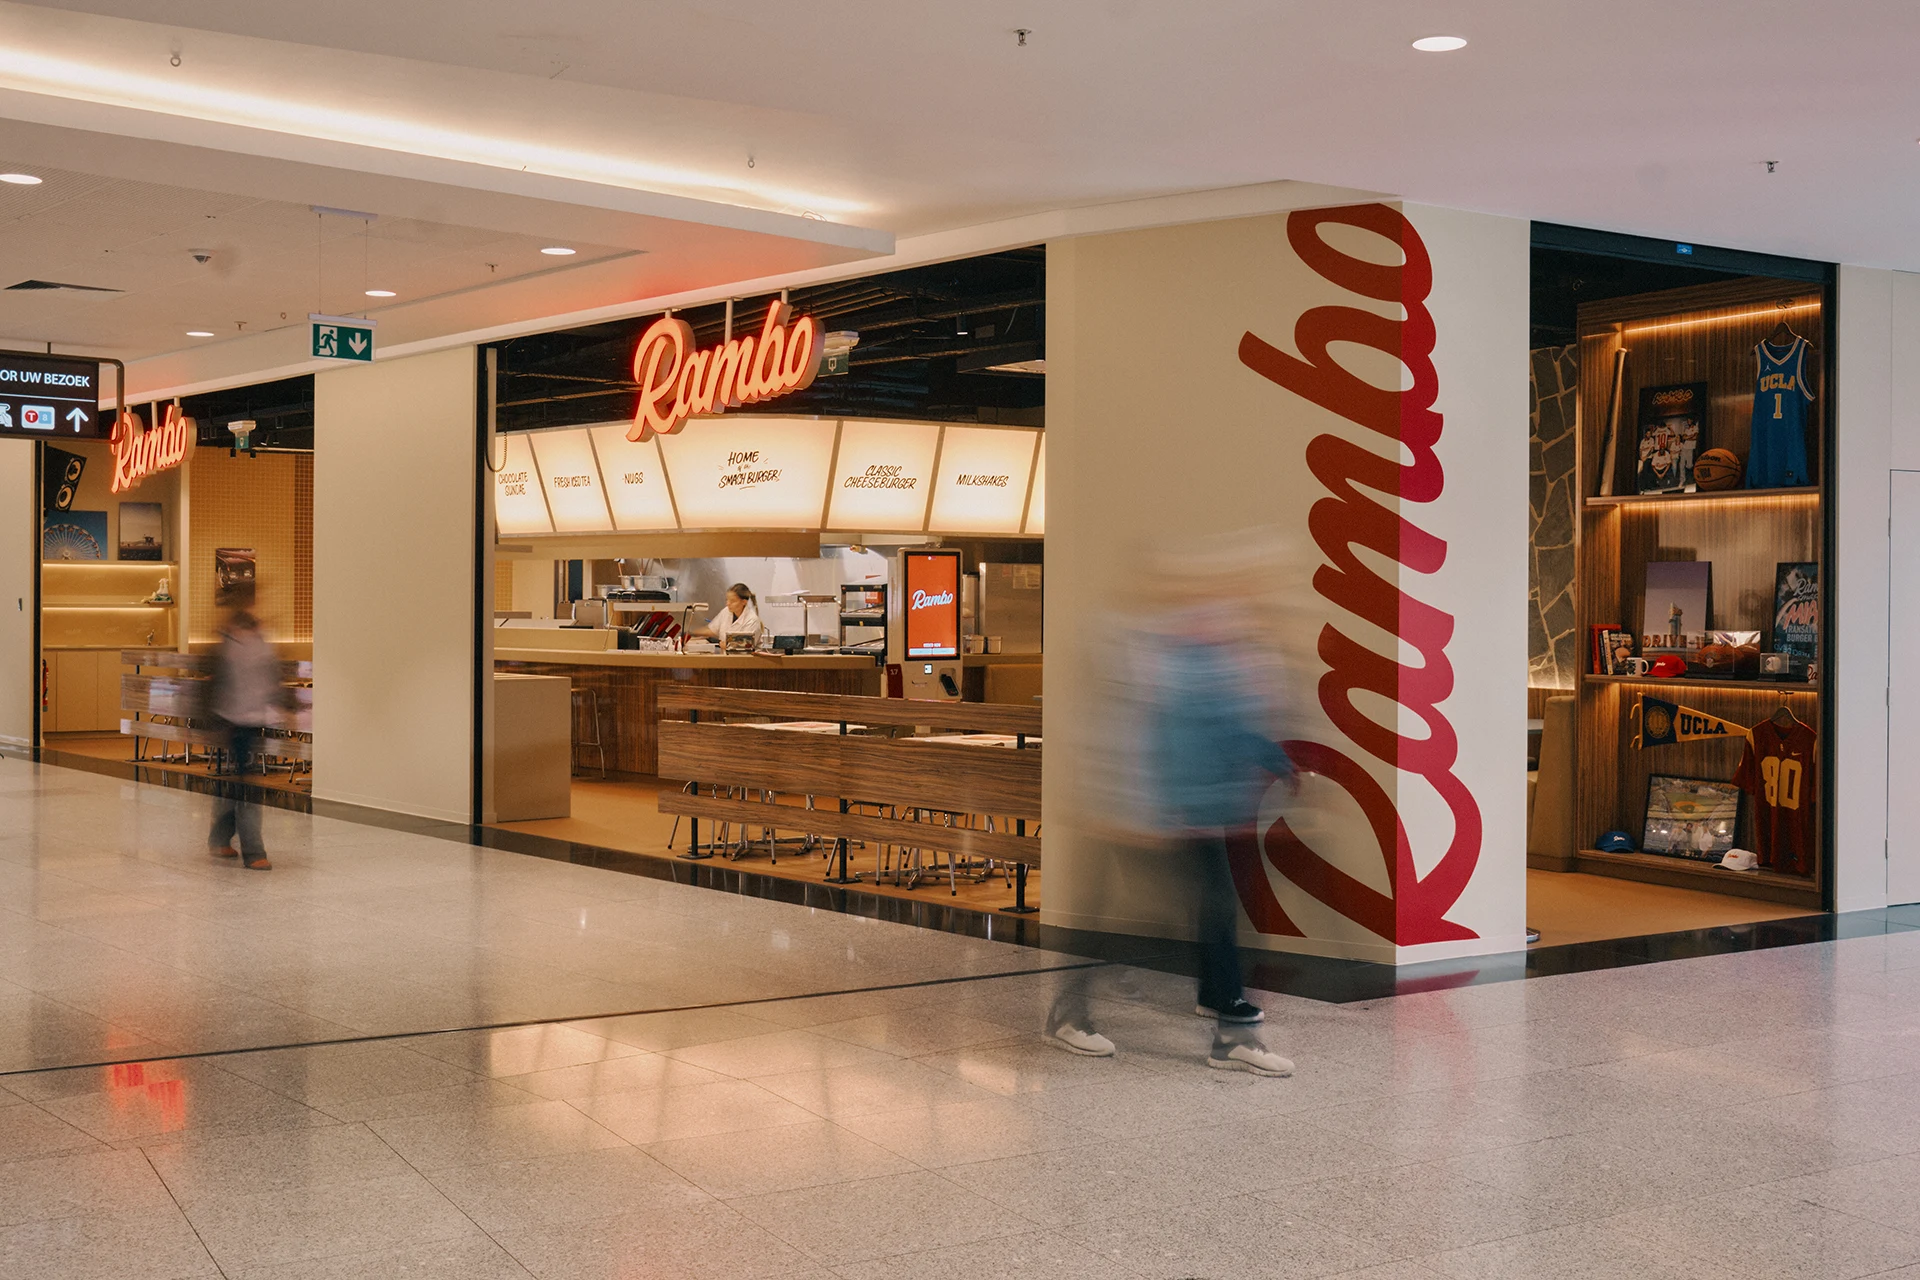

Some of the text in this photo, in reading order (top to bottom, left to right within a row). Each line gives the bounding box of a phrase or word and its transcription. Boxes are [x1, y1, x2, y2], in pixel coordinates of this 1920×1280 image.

[0, 369, 90, 388] OR UW BEZOEK
[626, 300, 821, 442] Rambo
[1760, 373, 1796, 392] UCLA
[1773, 393, 1783, 419] 1
[111, 405, 189, 494] Rambo
[727, 451, 760, 466] HOME
[498, 471, 529, 485] CHOCOLATE
[624, 471, 644, 485] NUGS
[865, 465, 902, 477] CLASSIC
[553, 476, 570, 488] FRESH
[581, 475, 591, 487] TEA
[718, 472, 747, 489] SMASH
[844, 476, 917, 490] CHEESEBURGER
[956, 474, 1009, 488] MILKSHAKES
[1224, 203, 1482, 946] Rambo
[912, 589, 953, 611] Rambo
[1787, 633, 1812, 643] BURGER
[890, 668, 899, 676] 17
[1680, 714, 1728, 735] UCLA
[1761, 756, 1802, 810] 80
